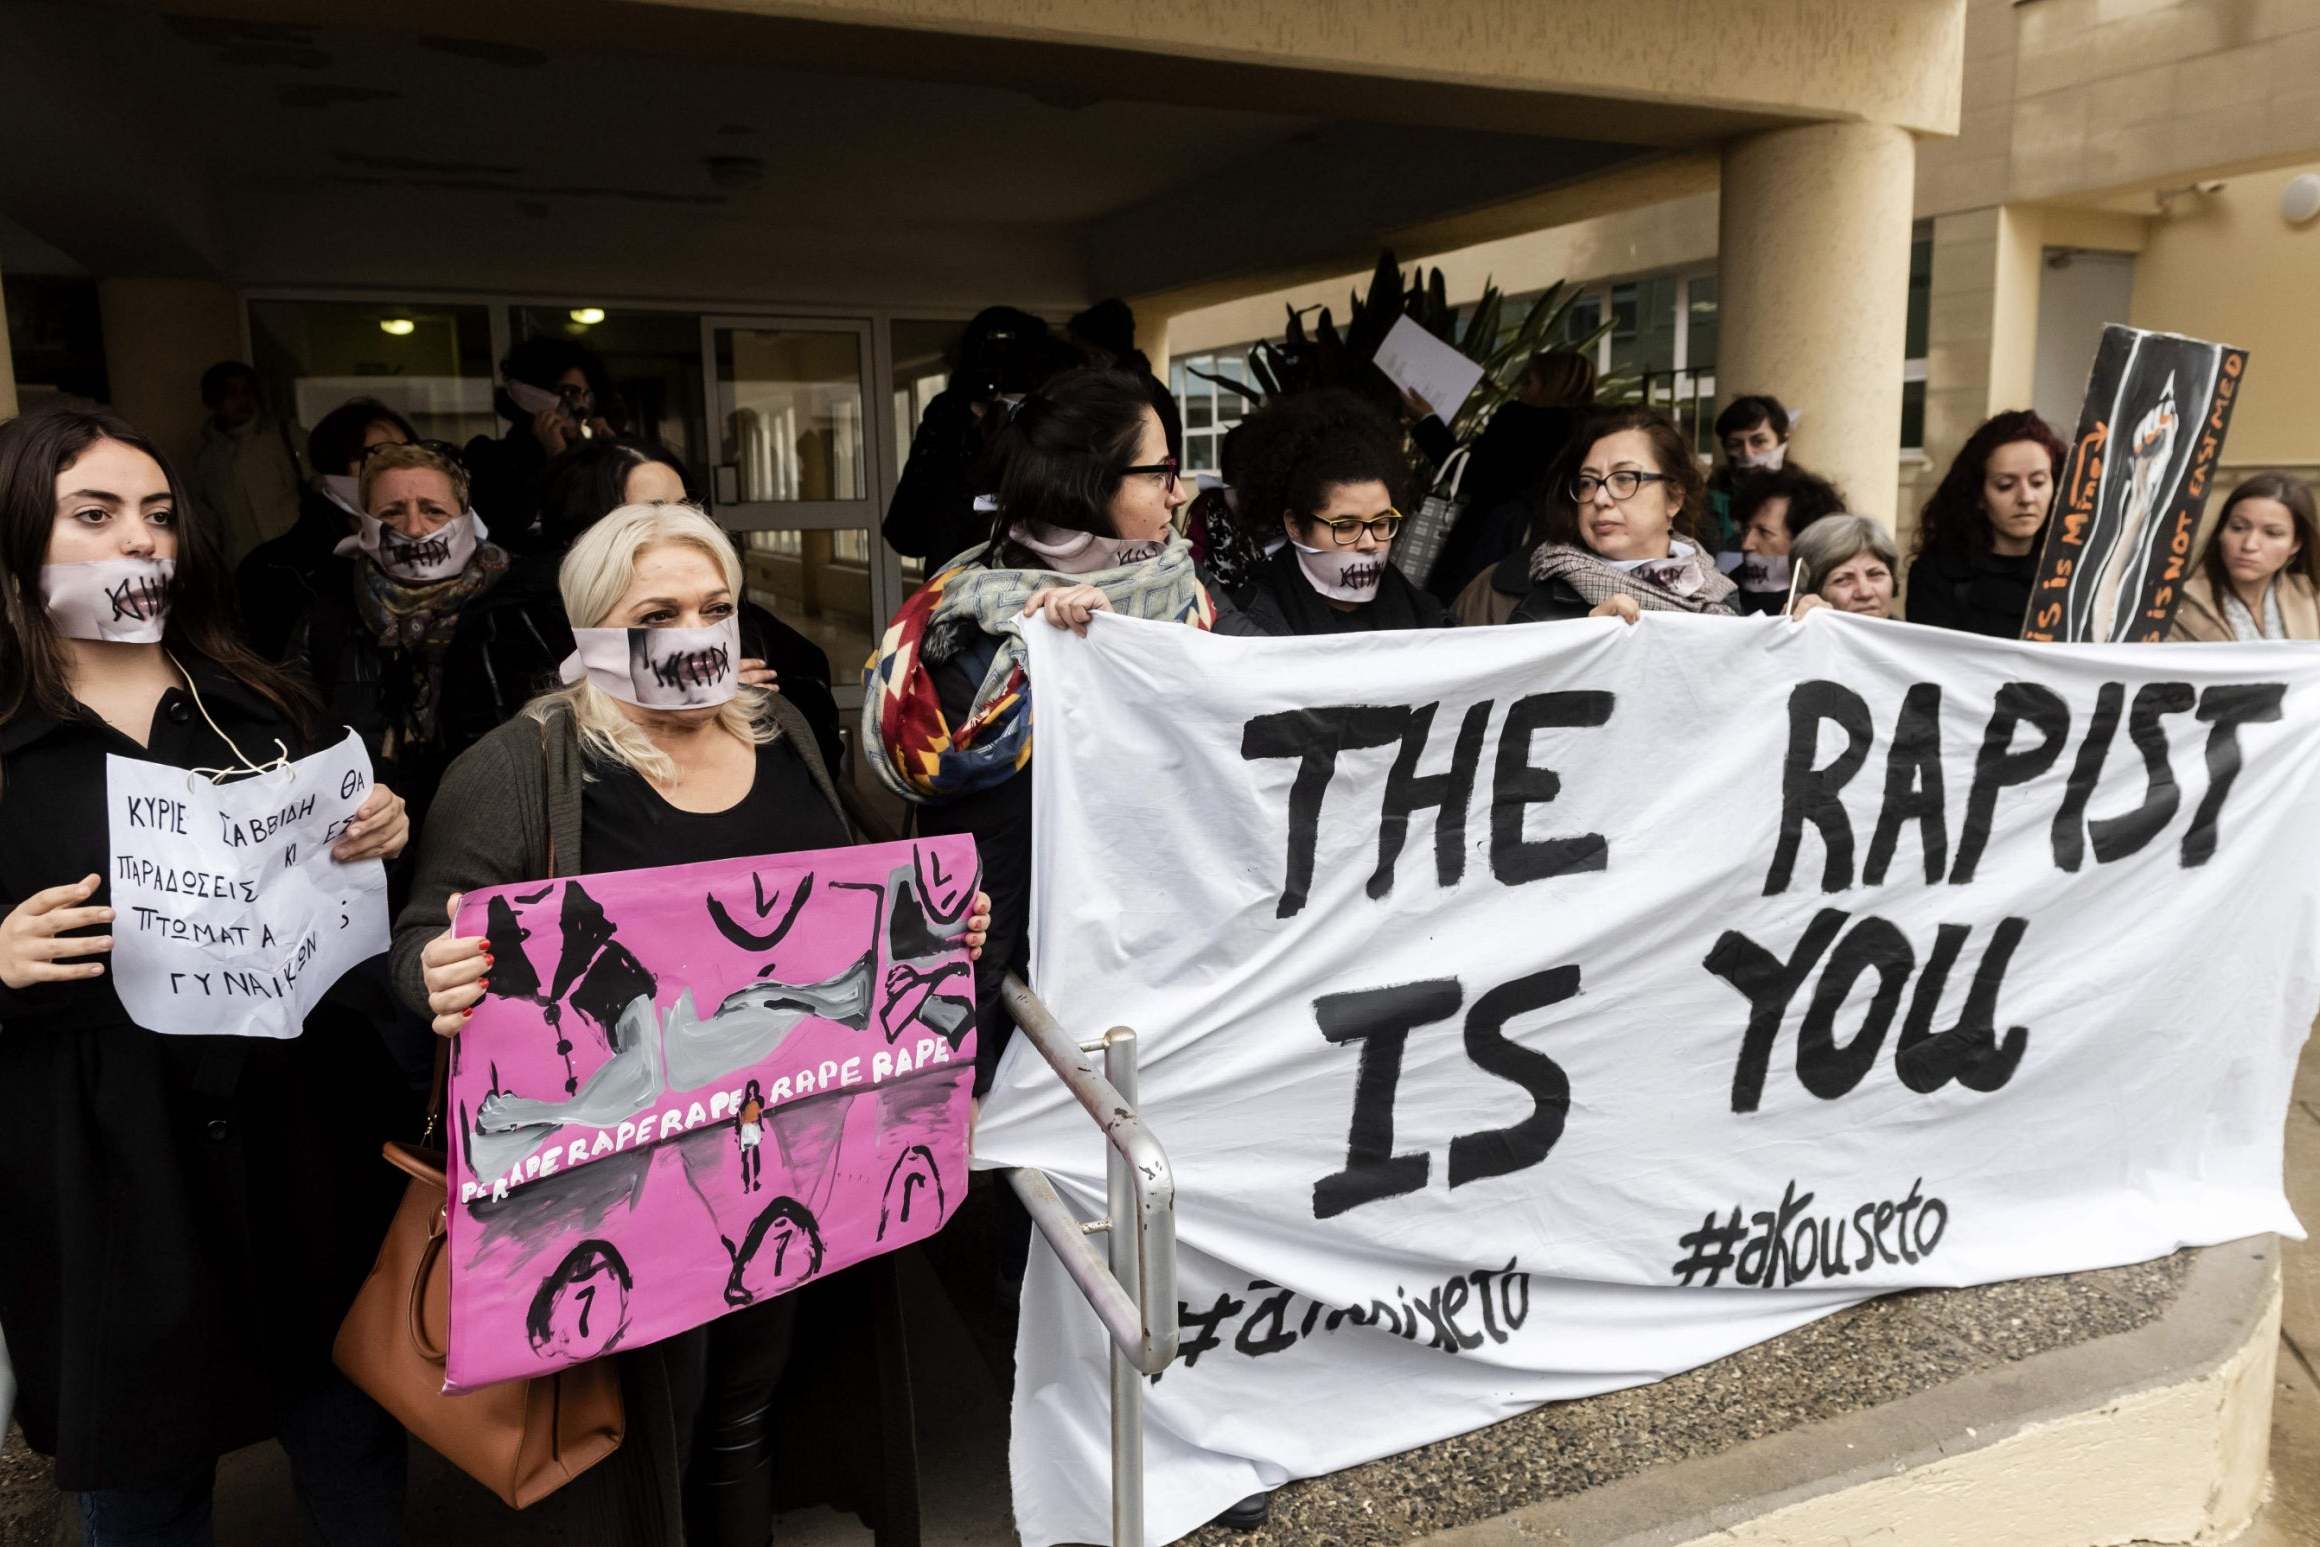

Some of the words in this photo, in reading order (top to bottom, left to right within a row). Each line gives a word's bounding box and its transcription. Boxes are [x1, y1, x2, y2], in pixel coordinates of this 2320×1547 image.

[2163, 509, 2193, 580] NOT
[127, 795, 188, 835] ΚΥΡΙΕ
[340, 769, 366, 800] ΘΑ
[1240, 690, 1617, 920] THE
[1761, 679, 2289, 897] RAPIST
[492, 1145, 563, 1204] RAPE
[567, 1114, 658, 1166] RAPE
[660, 1088, 742, 1140] RAPE
[769, 1056, 863, 1104] RAPE
[871, 1036, 950, 1084] RAPE
[1312, 964, 1587, 1220] IS
[1702, 907, 2030, 1114] YOU
[1672, 1176, 1949, 1289] #akouseto
